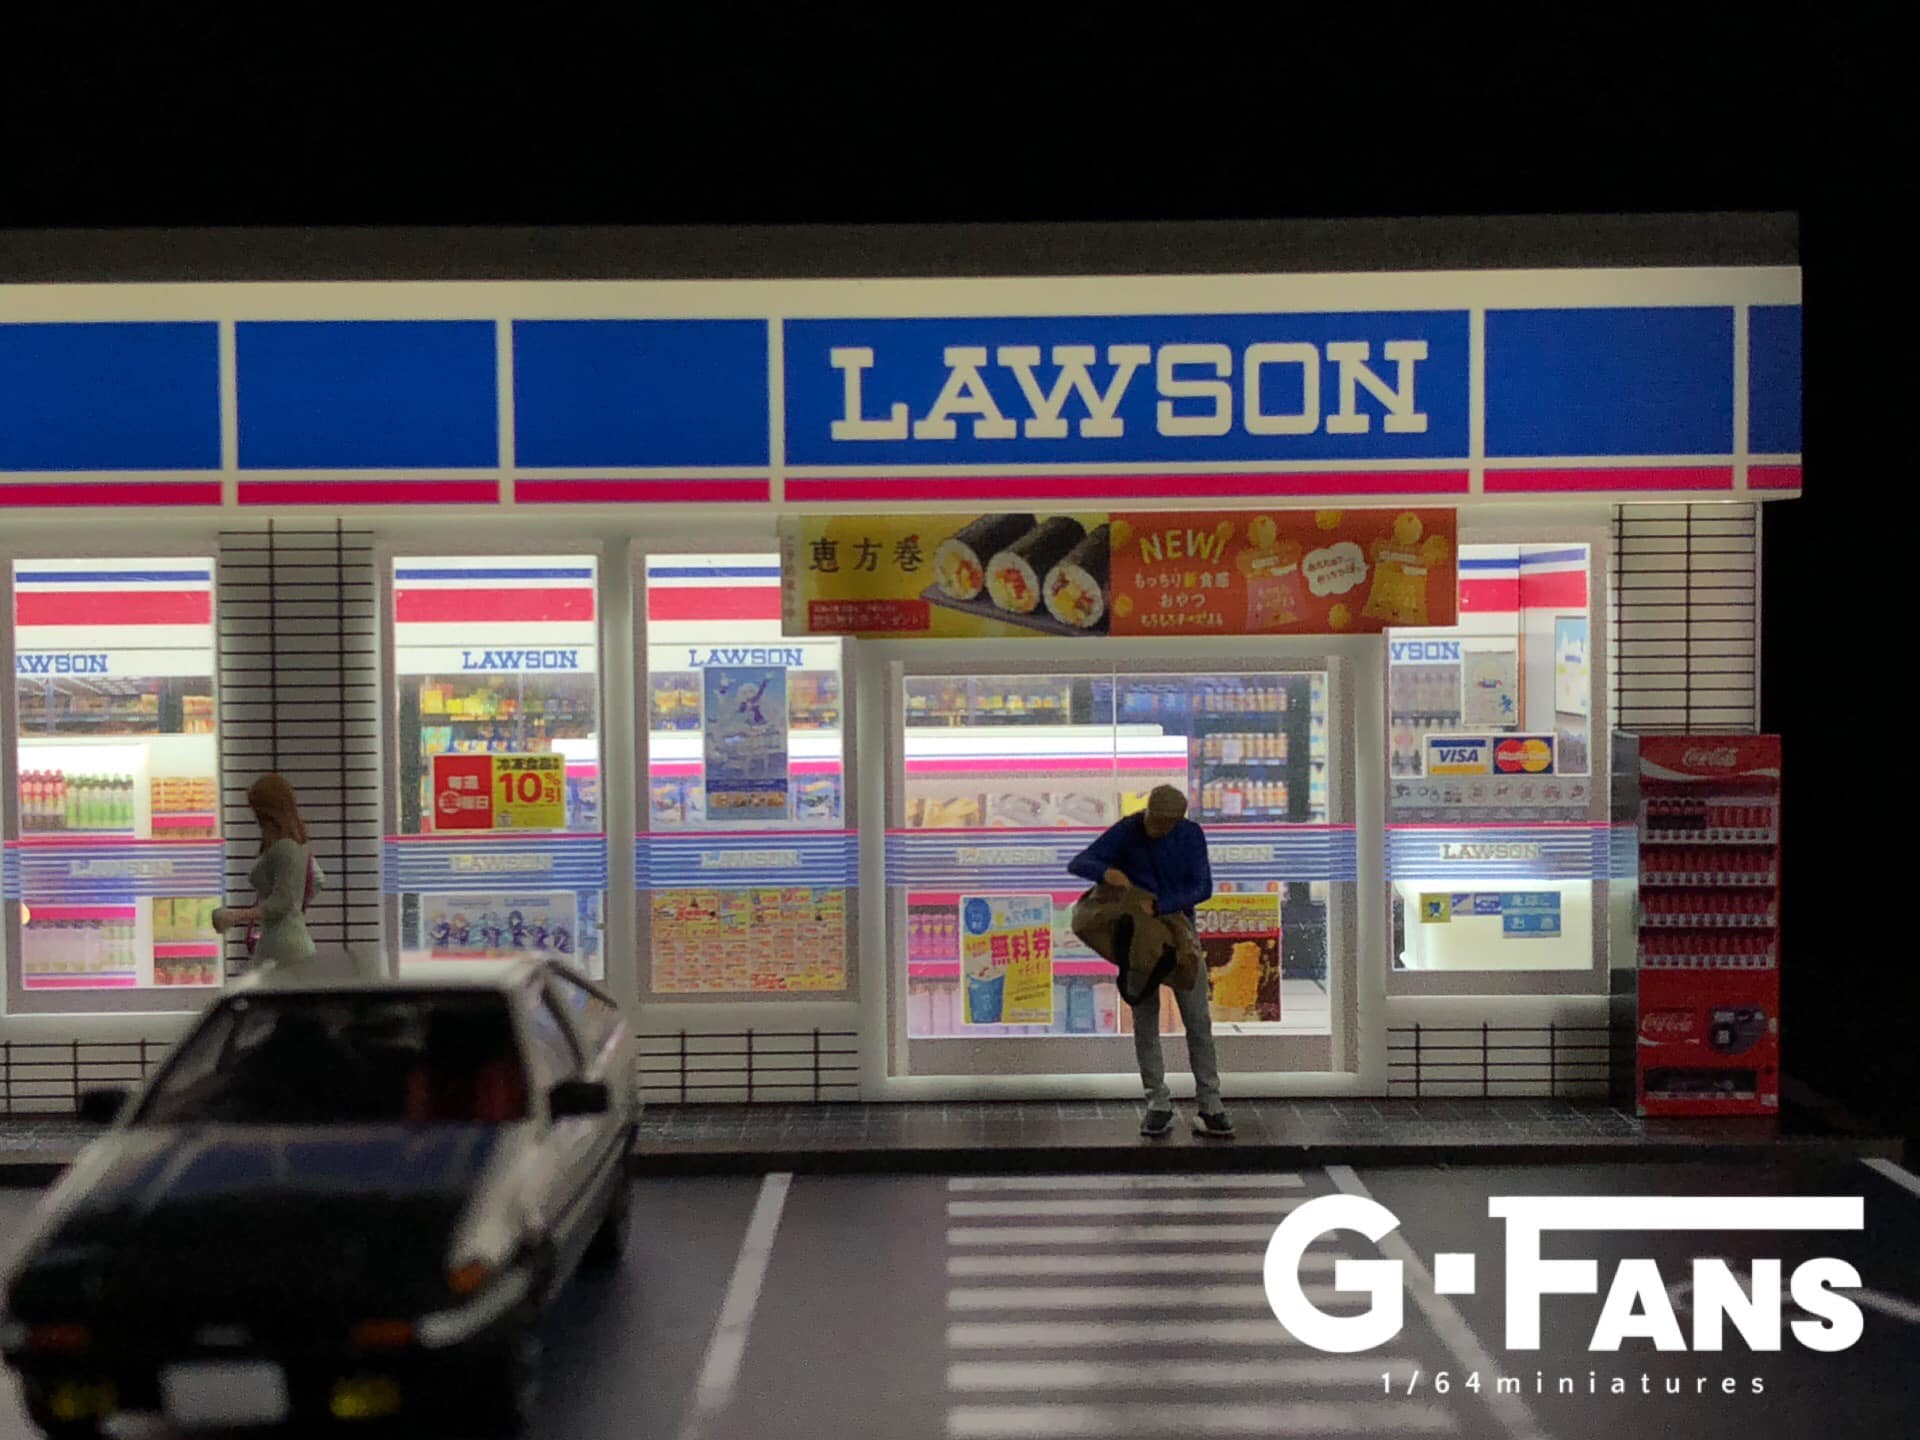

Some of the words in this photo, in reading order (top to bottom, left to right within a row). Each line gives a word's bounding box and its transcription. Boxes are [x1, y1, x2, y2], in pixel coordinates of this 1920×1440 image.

[831, 340, 1428, 440] LAWSON
[808, 536, 923, 572] 恵方巻
[1139, 525, 1230, 564] NEW!
[16, 654, 108, 673] AWSON
[462, 650, 578, 669] LAWSON
[689, 648, 803, 667] LAWSON
[1439, 750, 1479, 762] VISA
[1442, 843, 1539, 859] LAWSON
